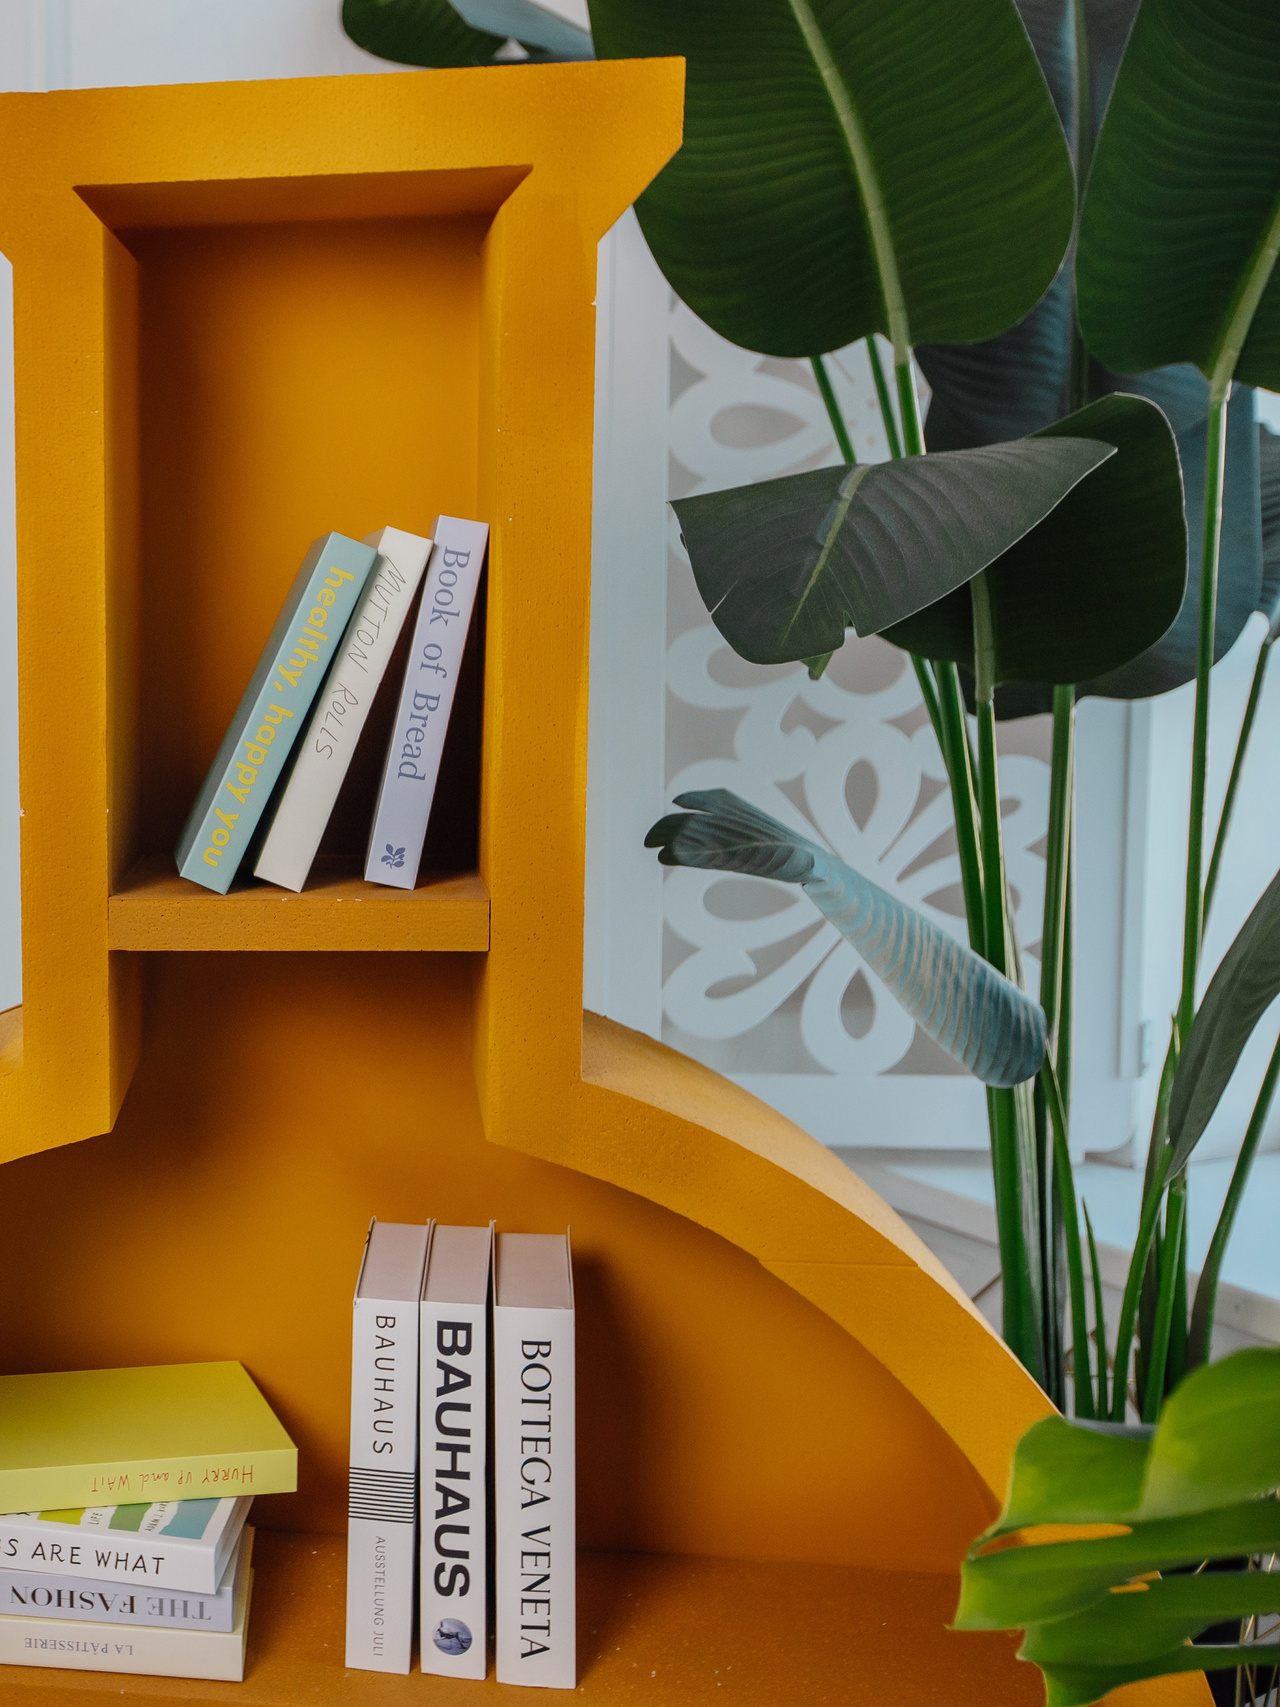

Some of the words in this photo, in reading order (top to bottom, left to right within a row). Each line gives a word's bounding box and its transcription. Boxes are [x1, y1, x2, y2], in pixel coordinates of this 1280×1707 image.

[347, 556, 406, 673] MUTTON
[429, 546, 471, 626] Book
[275, 566, 355, 694] healthy,
[421, 643, 448, 678] of
[226, 703, 294, 804] happy
[316, 683, 359, 759] ROLLS
[398, 689, 440, 781] Bread
[202, 808, 239, 867] you
[372, 1314, 396, 1455] BAUHAUS
[519, 1339, 552, 1510] BOTTEGA
[139, 1470, 170, 1492] and
[178, 1468, 194, 1484] UP
[202, 1464, 254, 1484] HURRY
[434, 1320, 472, 1598] BAUHAUS
[30, 1541, 81, 1566] ARE
[95, 1551, 165, 1576] WHAT
[373, 1535, 386, 1626] AUSSTELLUNG
[520, 1525, 551, 1659] VENETA
[10, 1585, 136, 1615] FASHON
[147, 1596, 211, 1621] THE
[24, 1637, 109, 1654] PÂTISSERIE
[114, 1644, 134, 1656] LA
[373, 1631, 383, 1657] JULI
